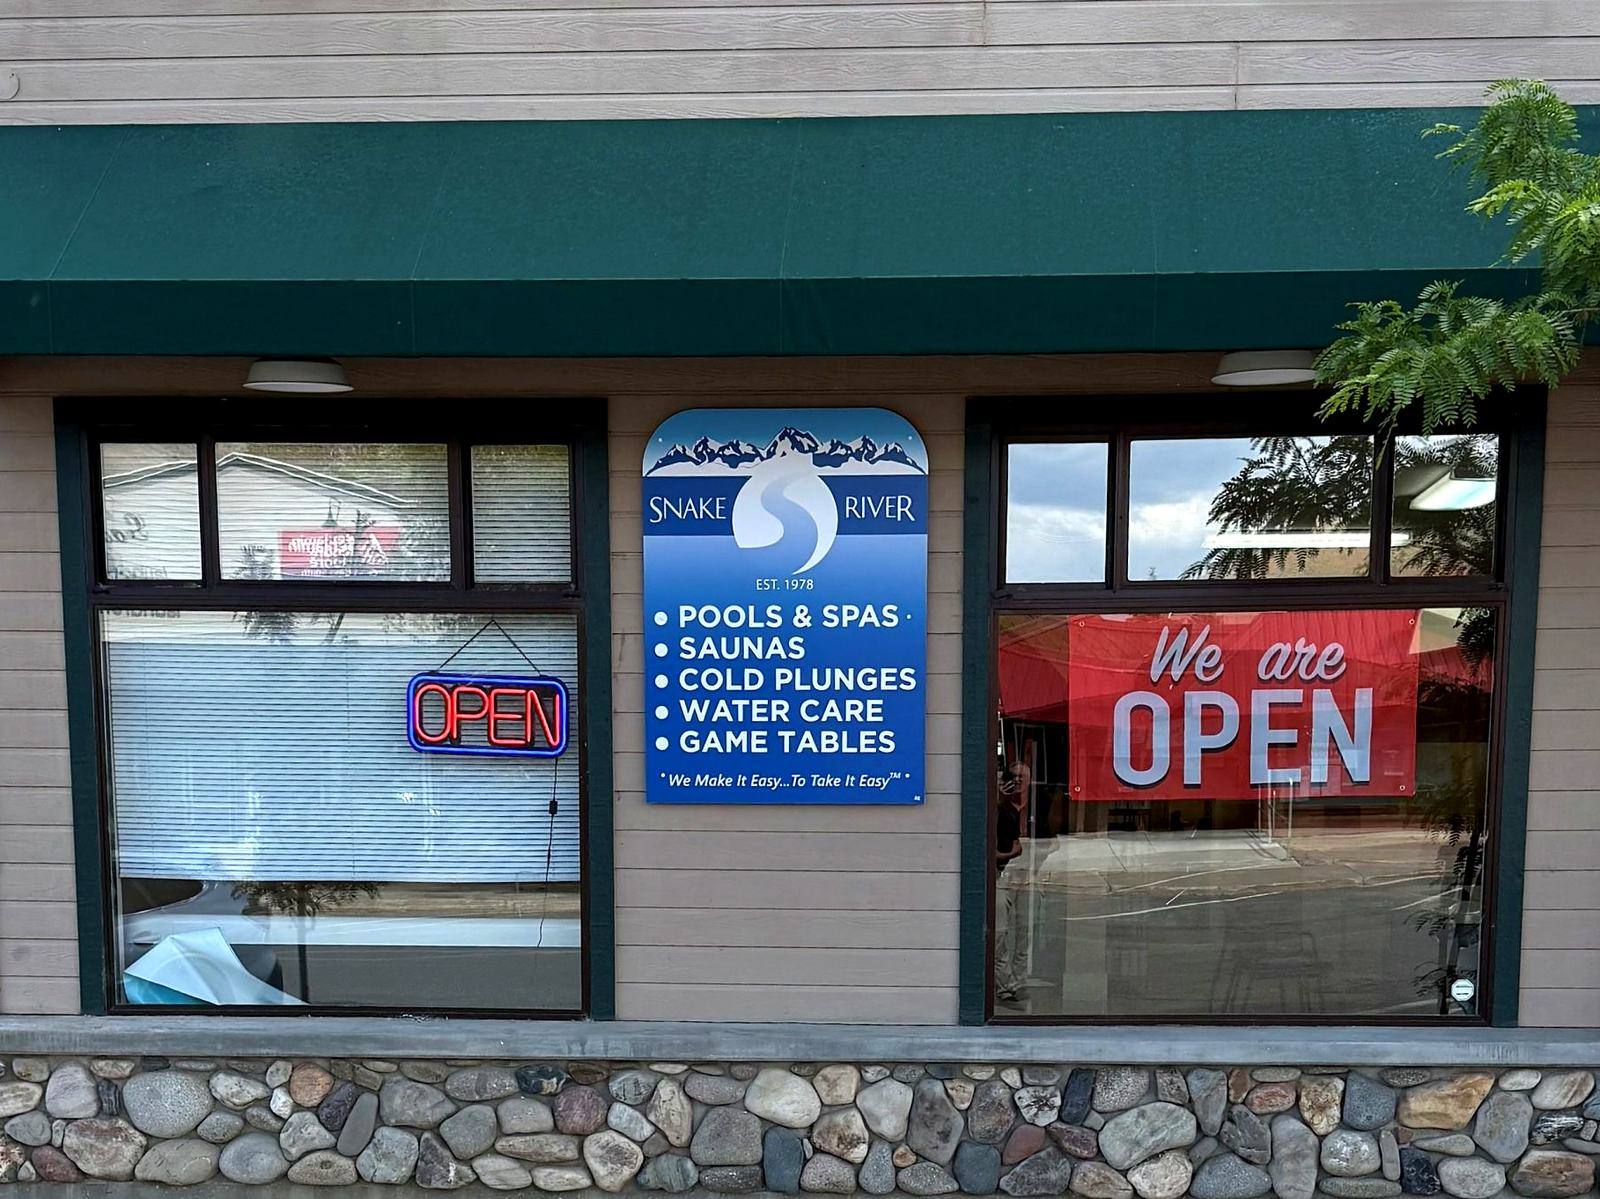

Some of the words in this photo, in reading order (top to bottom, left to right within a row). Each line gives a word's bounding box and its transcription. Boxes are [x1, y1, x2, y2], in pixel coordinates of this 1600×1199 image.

[649, 496, 727, 523] SNAKE
[845, 495, 915, 522] RIVER
[755, 578, 780, 591] EST.
[784, 578, 815, 591] 1978
[679, 604, 783, 628] POOLS
[792, 604, 812, 628] &
[822, 604, 899, 628] SPAS
[679, 636, 805, 660] SAUNAS
[1149, 624, 1224, 683] We
[1257, 637, 1347, 682] are
[679, 667, 764, 691] COLD
[775, 667, 917, 691] PLUNGES
[413, 683, 561, 748] OPEN
[679, 699, 790, 722] WATER
[800, 699, 884, 723] CARE
[680, 730, 768, 753] GAME
[777, 730, 896, 753] TABLES
[1112, 687, 1374, 788] OPEN
[669, 773, 691, 787] We
[694, 773, 734, 787] Make
[736, 774, 748, 787] It
[810, 773, 842, 787] Take
[844, 774, 856, 787] It
